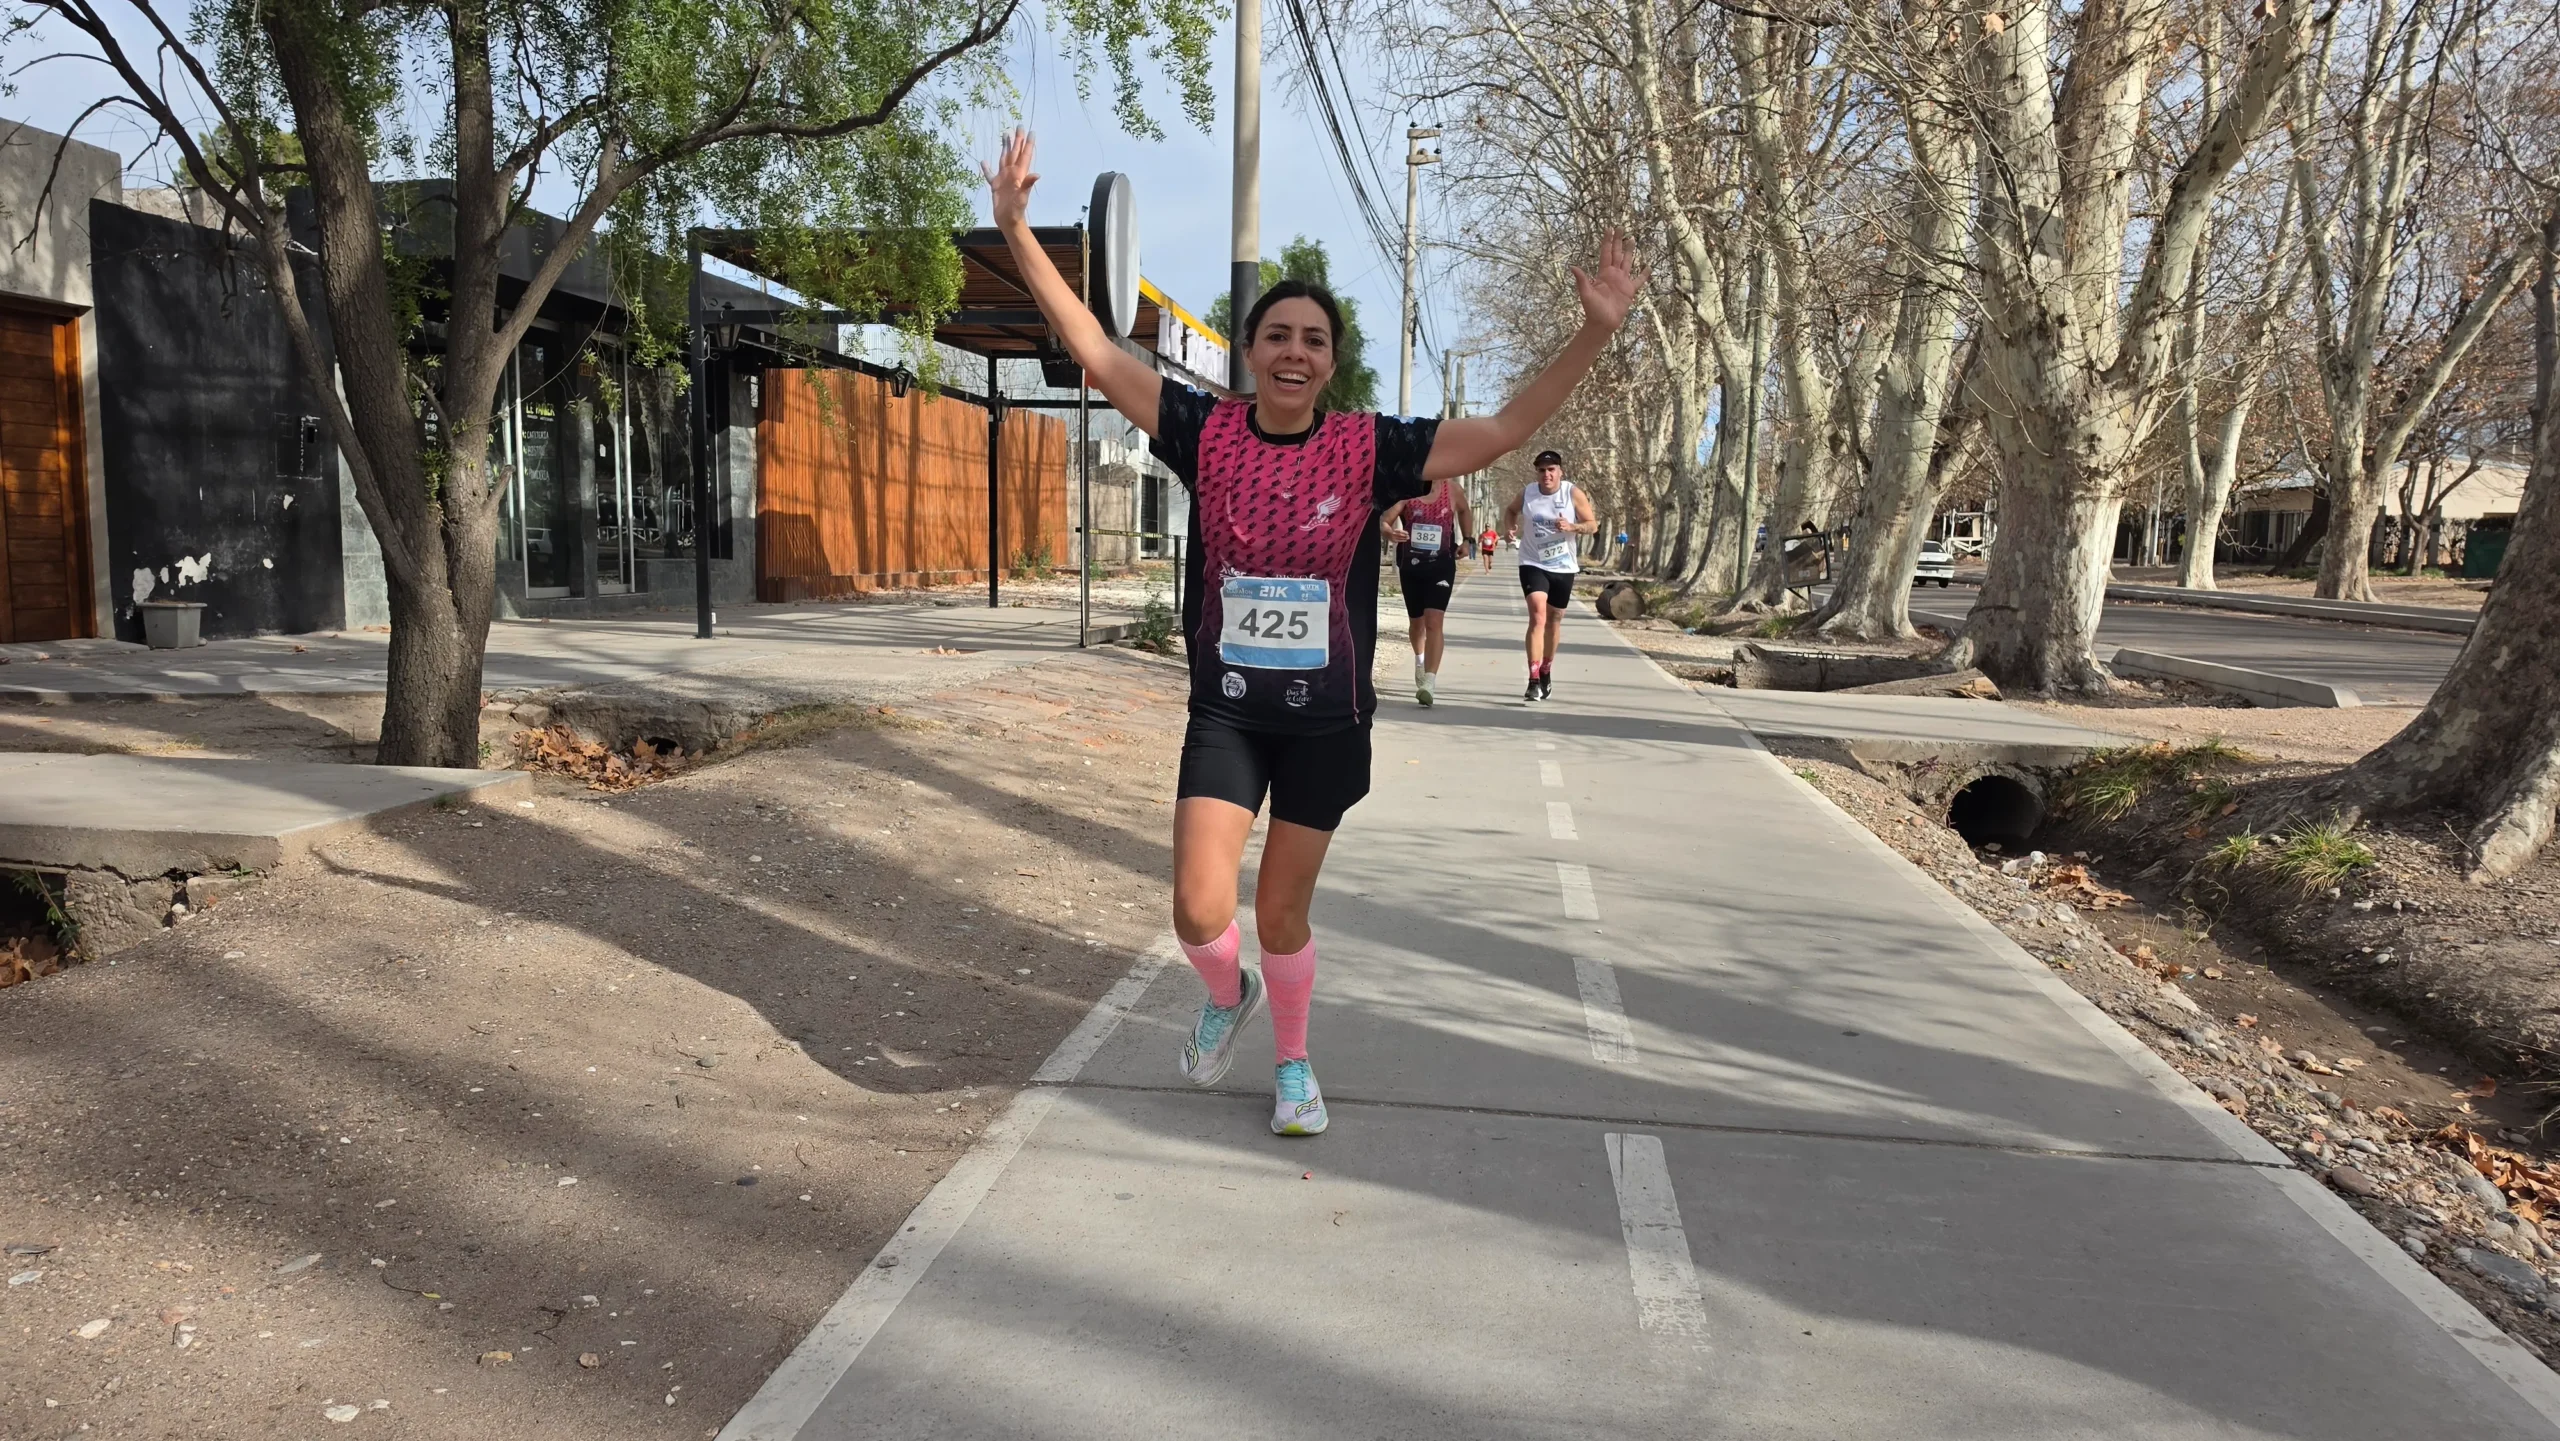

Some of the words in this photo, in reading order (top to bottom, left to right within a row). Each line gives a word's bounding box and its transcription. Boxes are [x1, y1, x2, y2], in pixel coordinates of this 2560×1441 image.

[1416, 532, 1436, 542] 382
[1544, 545, 1564, 558] 372
[1259, 585, 1288, 598] 21K
[1238, 608, 1309, 640] 425
